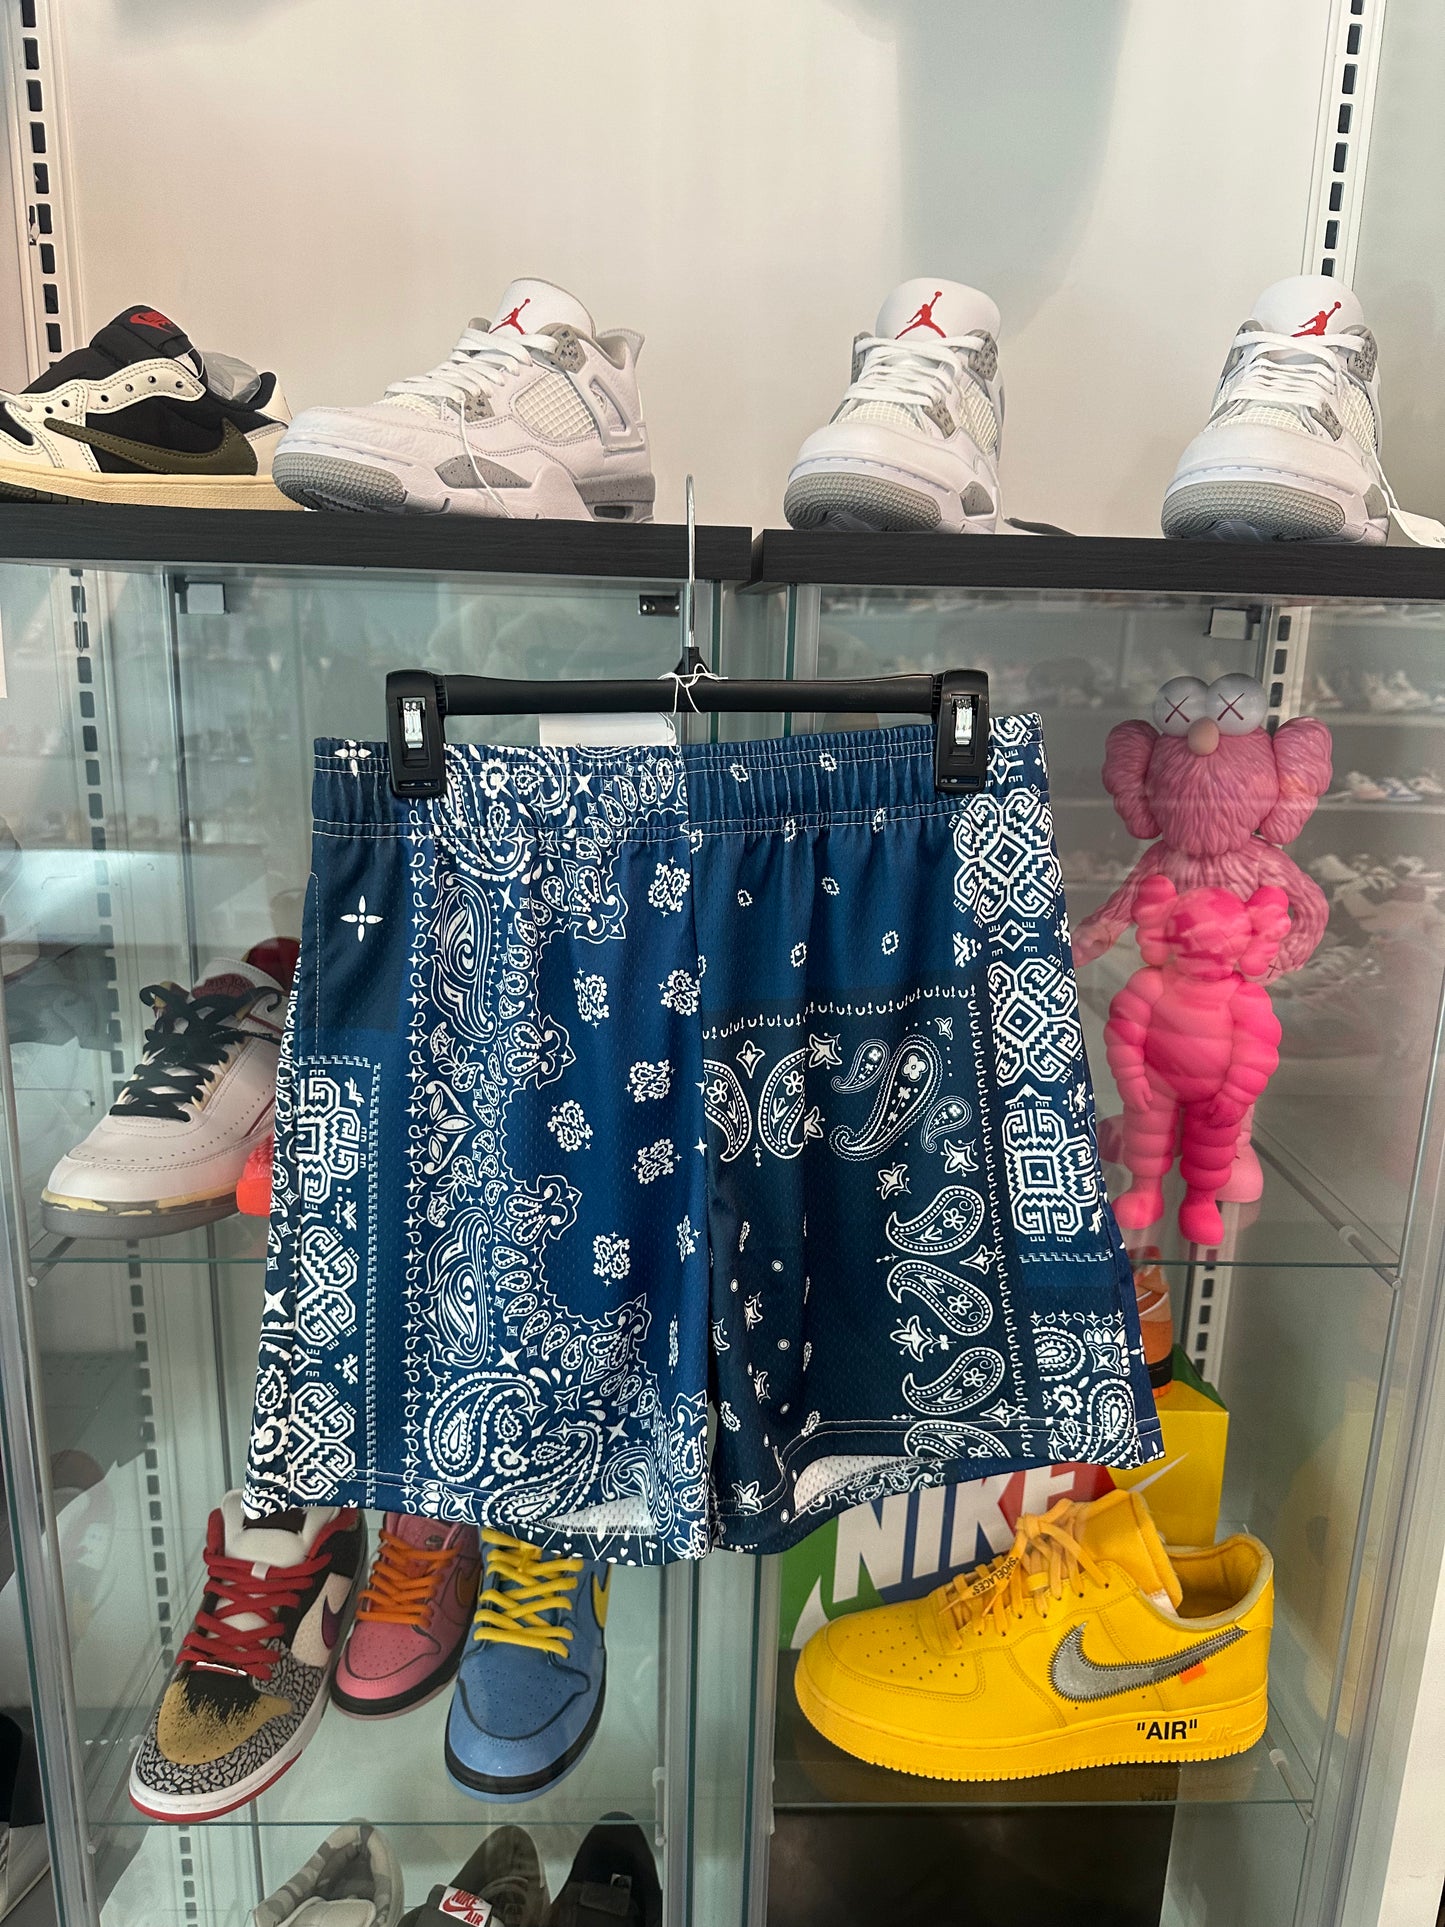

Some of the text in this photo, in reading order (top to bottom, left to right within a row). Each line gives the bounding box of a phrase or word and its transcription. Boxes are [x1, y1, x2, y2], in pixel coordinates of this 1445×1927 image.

[1136, 1718, 1198, 1740] "AIR"
[451, 1889, 480, 1907] NIKE
[463, 1912, 484, 1926] AIR
